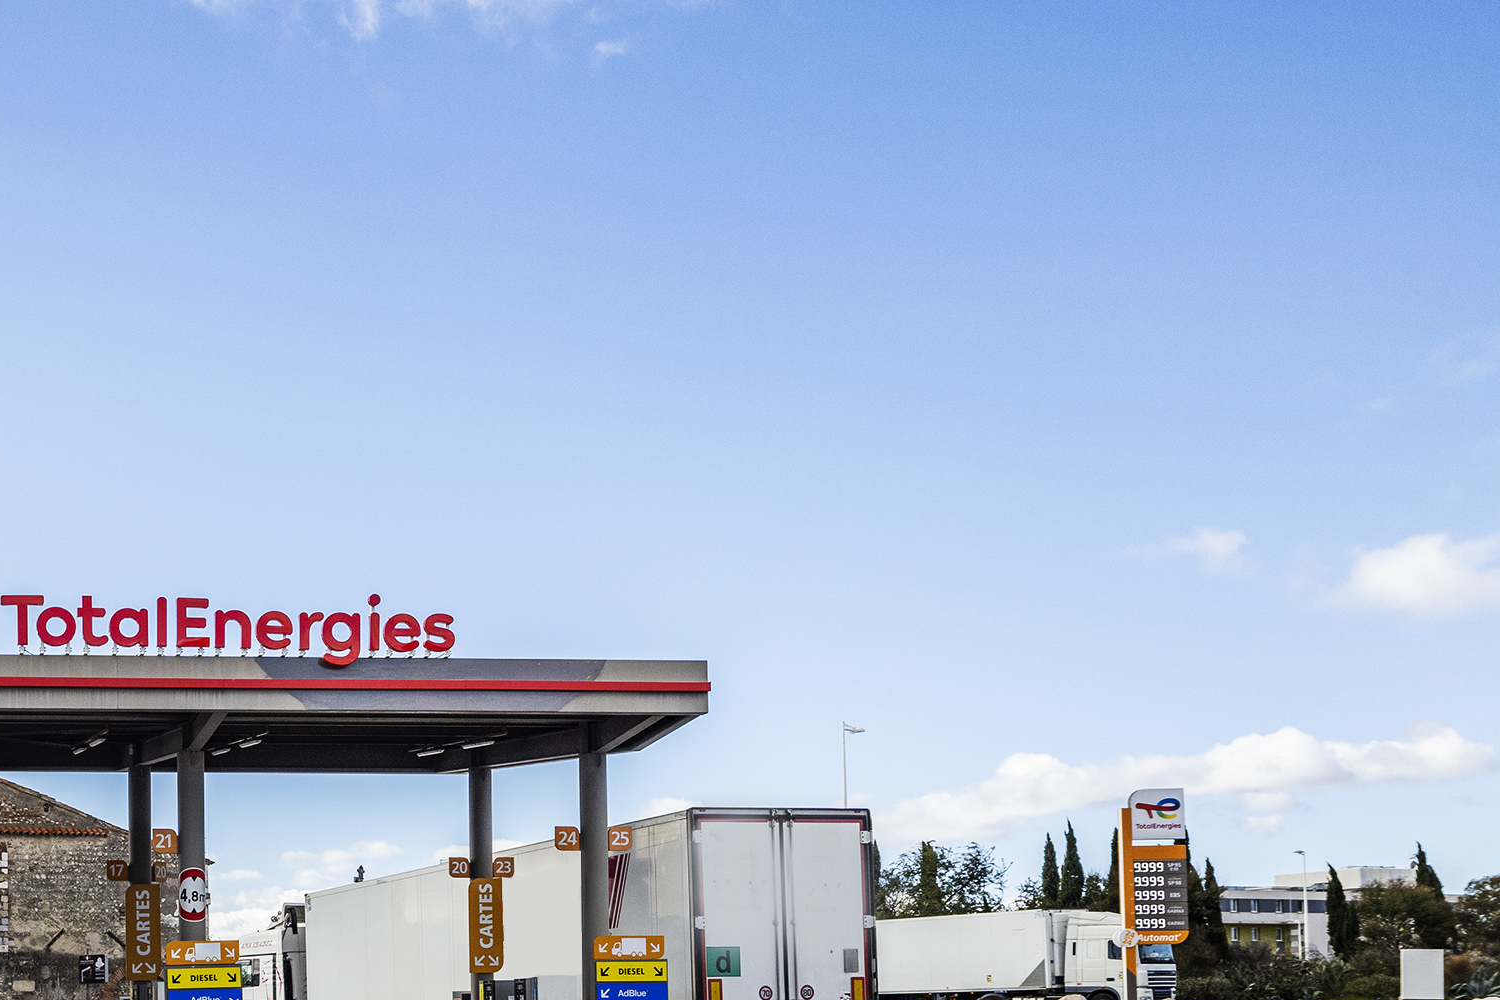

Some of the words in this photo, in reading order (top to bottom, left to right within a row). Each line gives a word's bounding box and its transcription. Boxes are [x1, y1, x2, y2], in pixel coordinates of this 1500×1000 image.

[0, 594, 456, 667] TotalEnergies
[1135, 823, 1182, 831] TotalEnergies
[155, 833, 172, 849] 21
[558, 831, 578, 846] 24
[611, 831, 630, 846] 25
[109, 864, 124, 877] 17
[156, 865, 167, 879] 20
[451, 861, 468, 874] 20
[496, 862, 512, 874] 23
[478, 882, 494, 949] CARTES
[135, 889, 151, 956] CARTES
[252, 940, 273, 949] ISABEL
[715, 950, 731, 974] d
[190, 974, 218, 982] DIESEL
[618, 967, 645, 976] DIESEL
[617, 989, 647, 997] AdBlue
[762, 989, 771, 998] 70
[802, 988, 812, 997] 80
